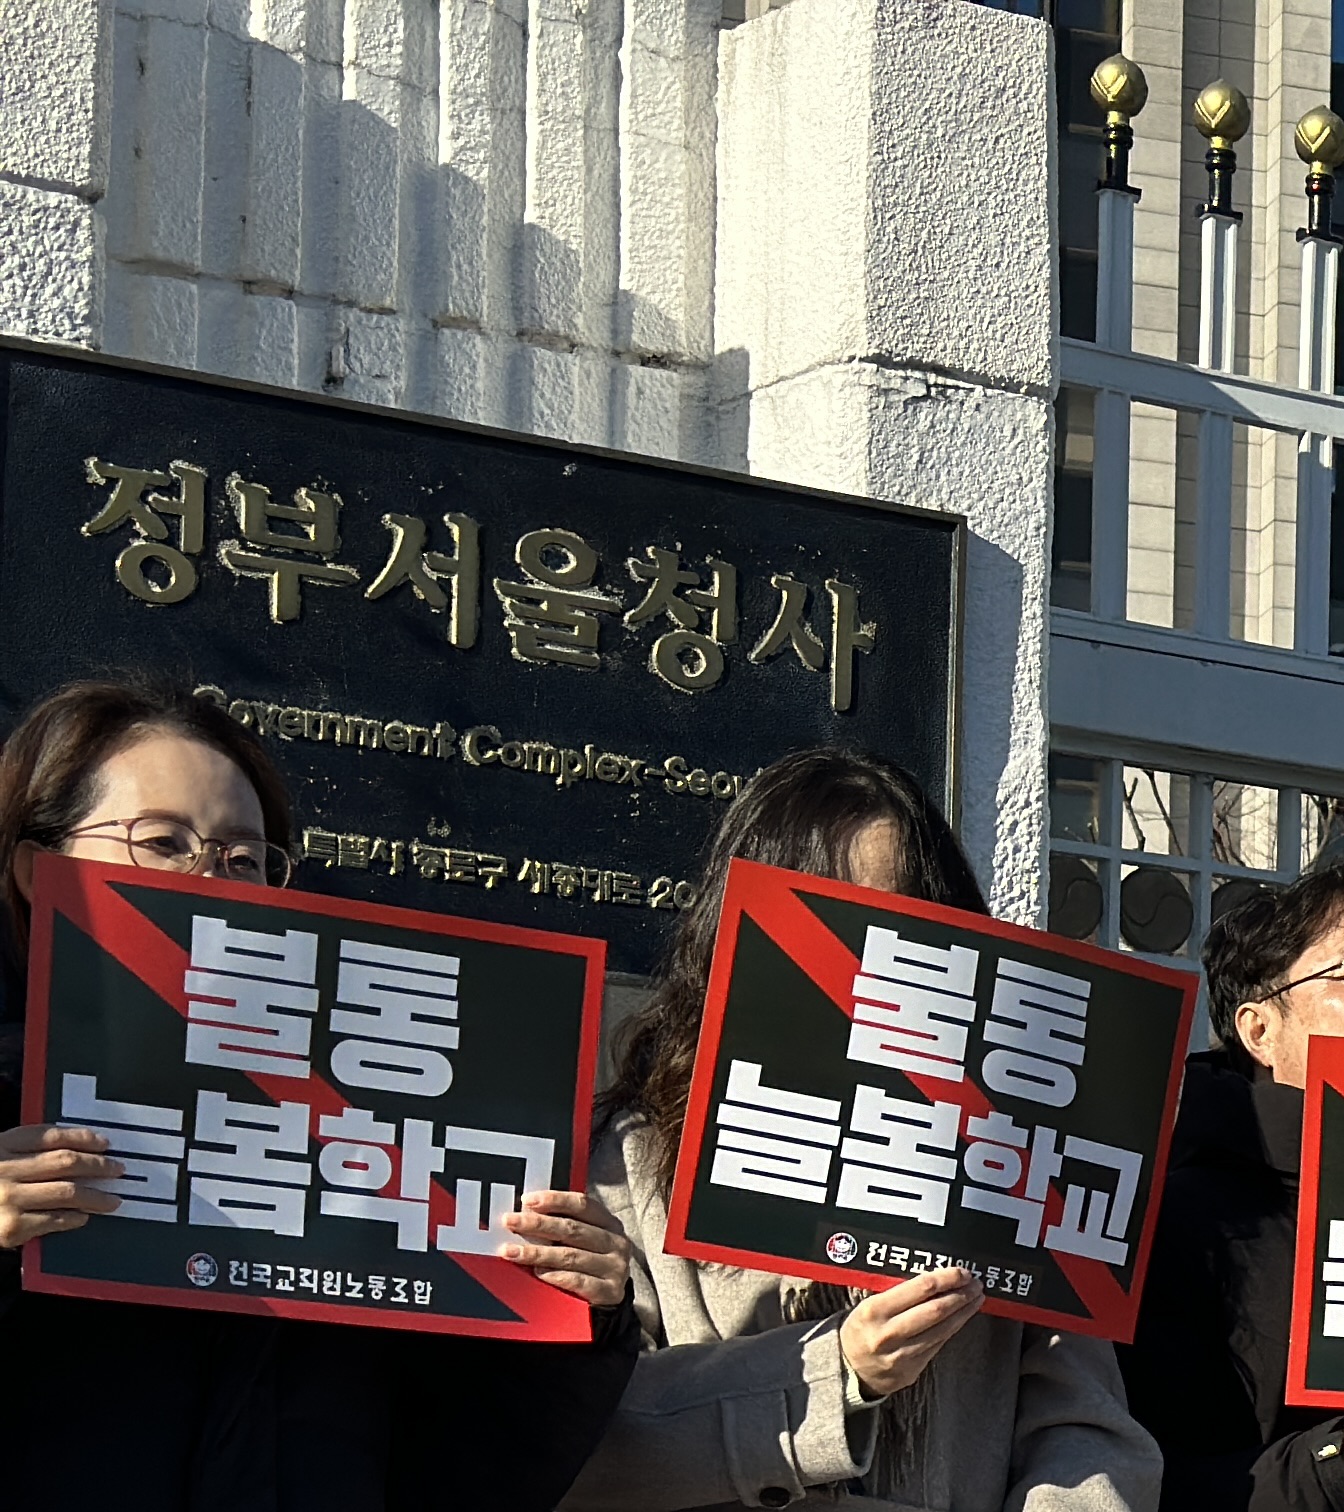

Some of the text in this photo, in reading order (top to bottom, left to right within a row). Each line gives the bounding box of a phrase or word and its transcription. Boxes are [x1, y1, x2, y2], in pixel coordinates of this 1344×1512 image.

[81, 455, 877, 713] 정부서울청사
[460, 723, 763, 799] Complex-Seo
[184, 914, 460, 1097] 불통
[847, 925, 1092, 1108] 불통
[55, 1073, 555, 1257] 늘봄학교
[710, 1059, 1143, 1266] 늘봄학교
[228, 1259, 433, 1305] 전국교직원노동조합
